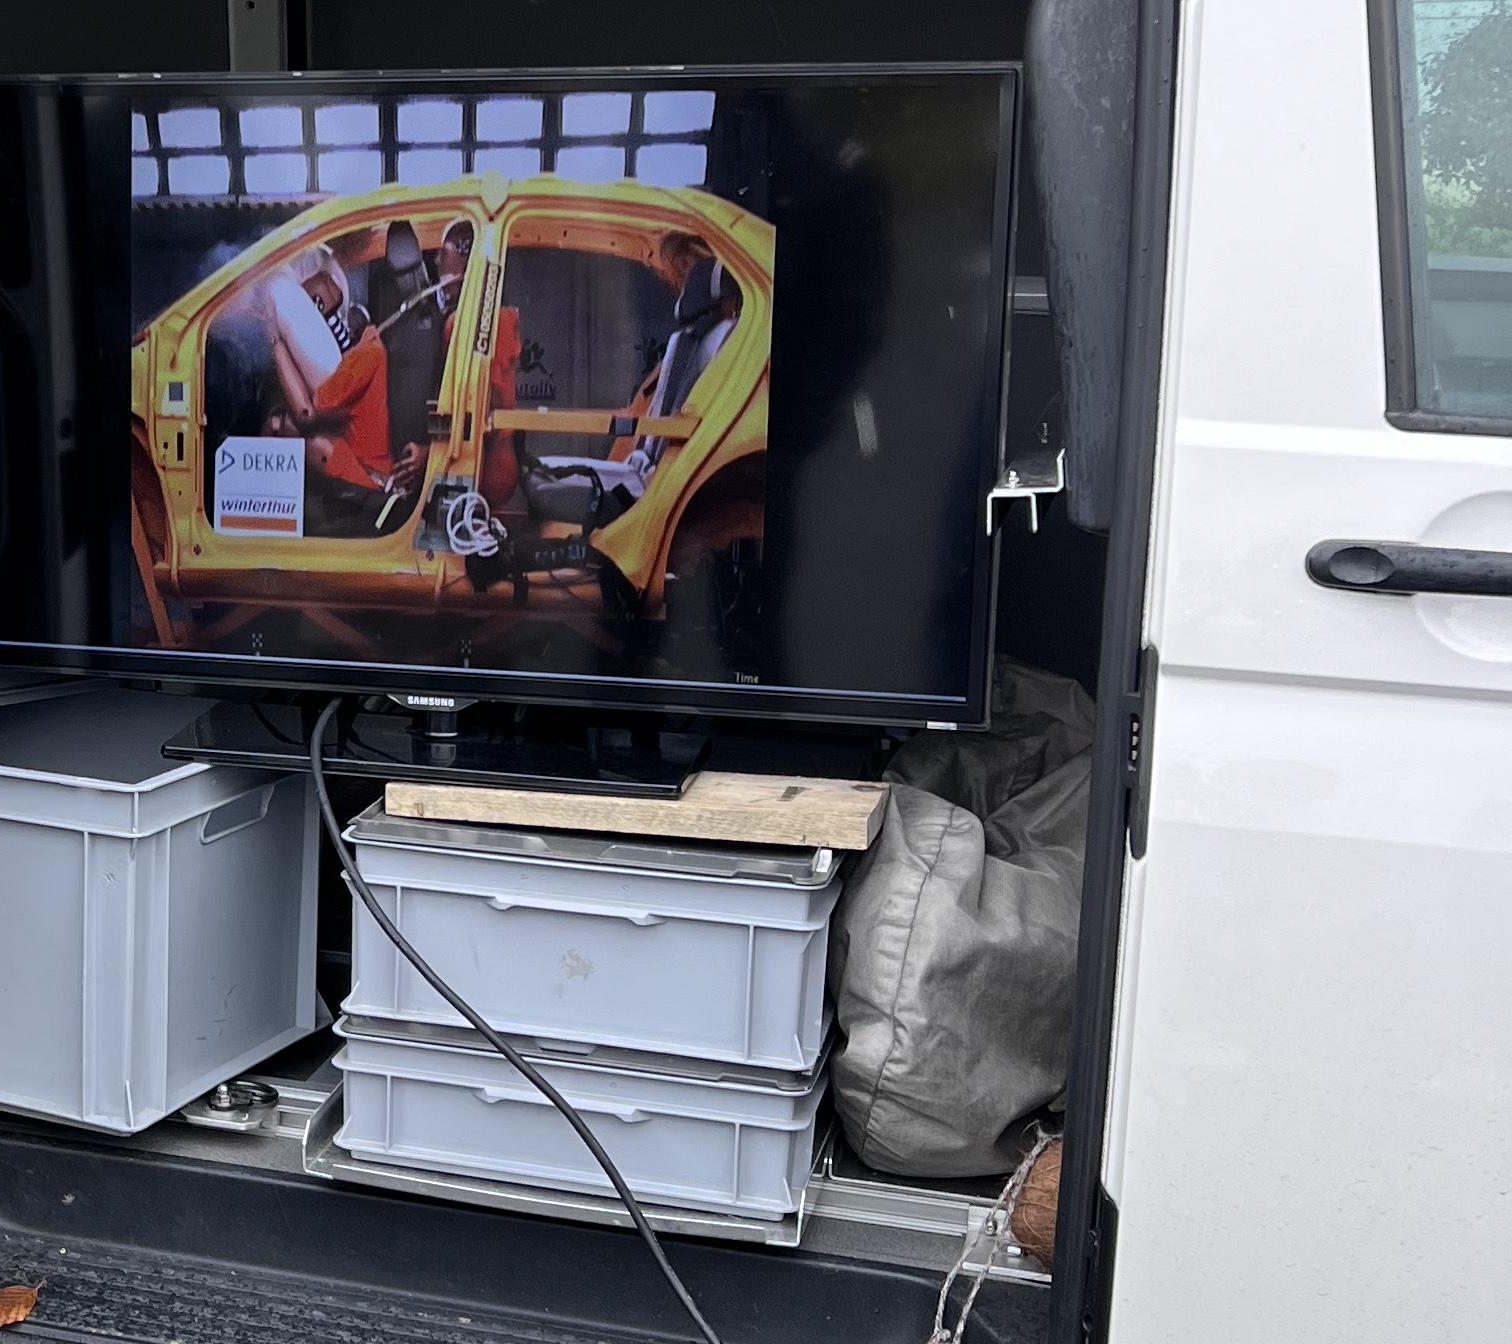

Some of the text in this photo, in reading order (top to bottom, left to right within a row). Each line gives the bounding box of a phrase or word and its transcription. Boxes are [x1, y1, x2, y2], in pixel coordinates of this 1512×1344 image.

[243, 453, 297, 472] DEKRA
[221, 498, 296, 515] winterthur
[734, 671, 759, 684] Time
[407, 695, 455, 708] SAMSUNG
